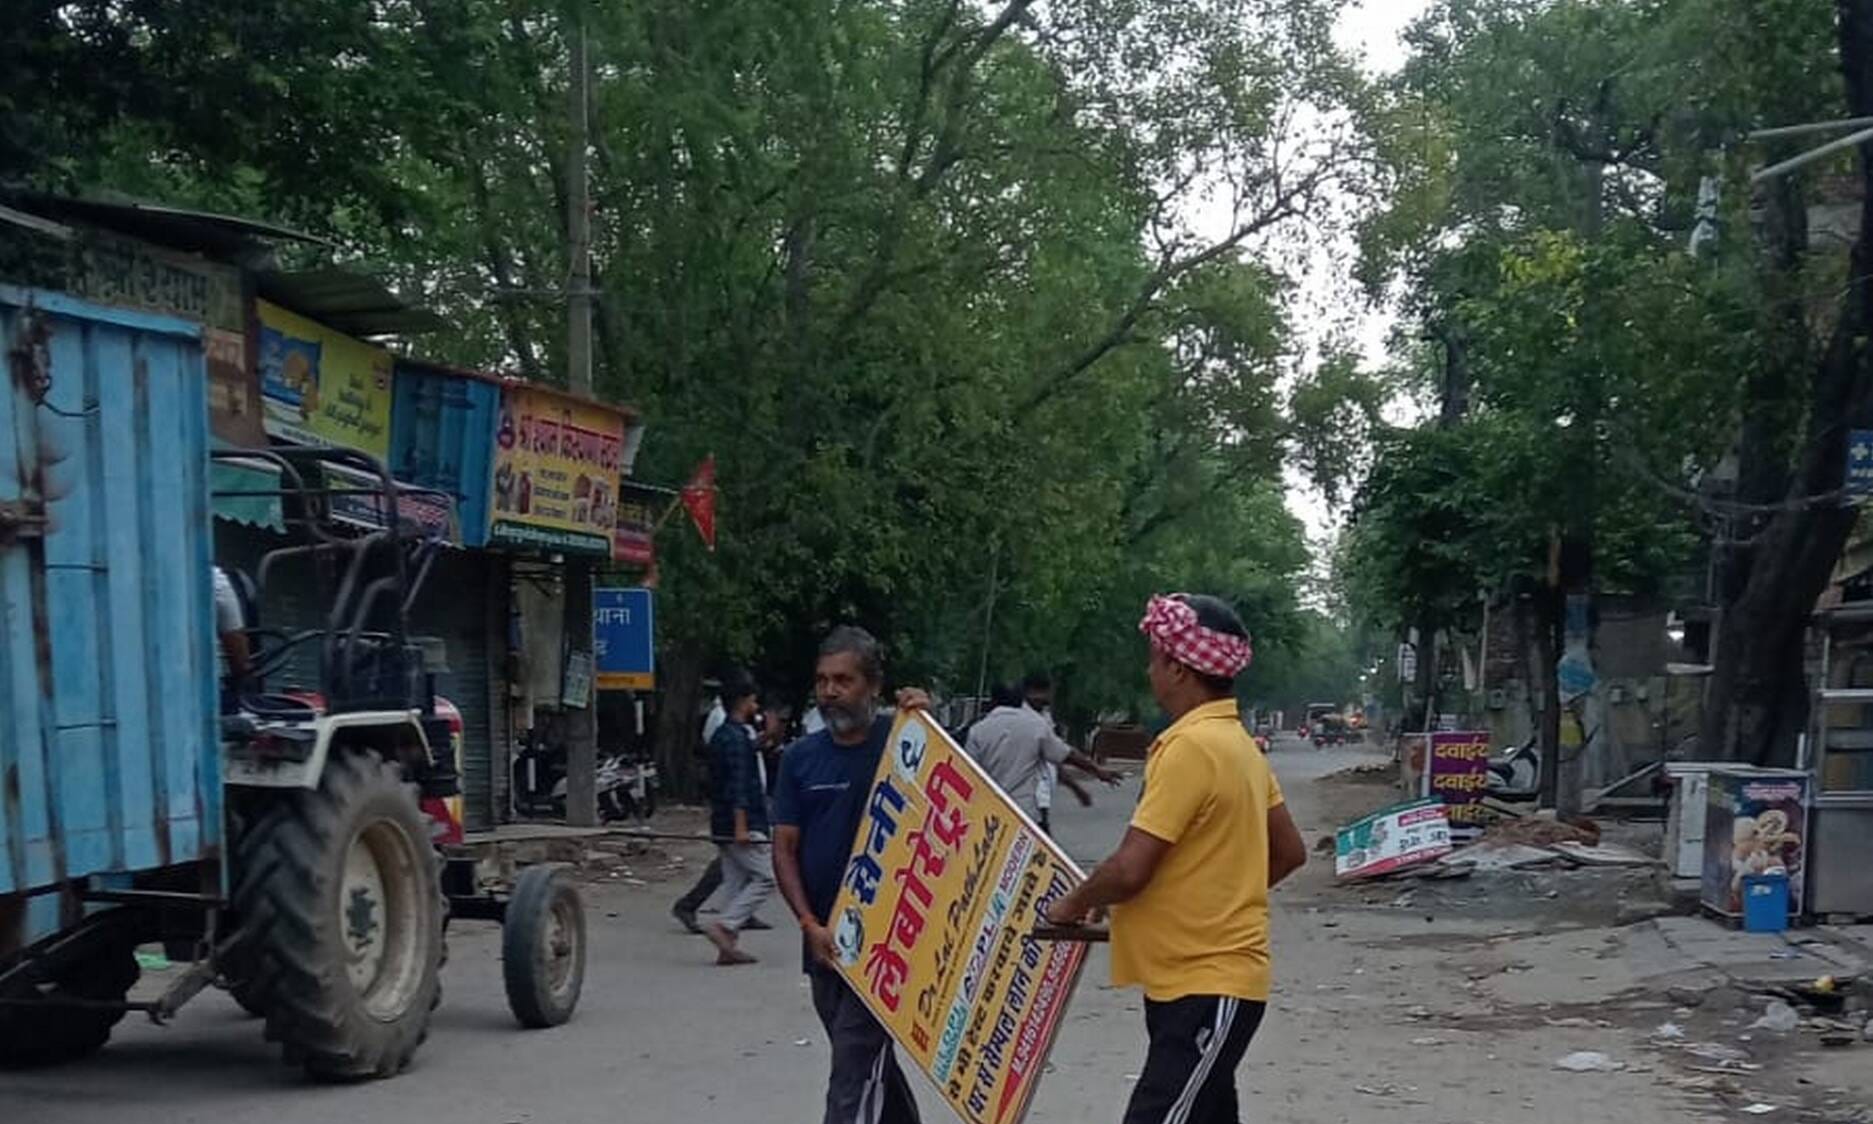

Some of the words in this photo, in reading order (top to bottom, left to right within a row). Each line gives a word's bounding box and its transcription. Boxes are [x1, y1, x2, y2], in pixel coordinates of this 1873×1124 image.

[844, 774, 906, 905] सैनी
[1000, 832, 1030, 895] MODERN
[975, 1060, 996, 1089] से
[1005, 960, 1033, 1014] लाने
[1020, 933, 1043, 970] की
